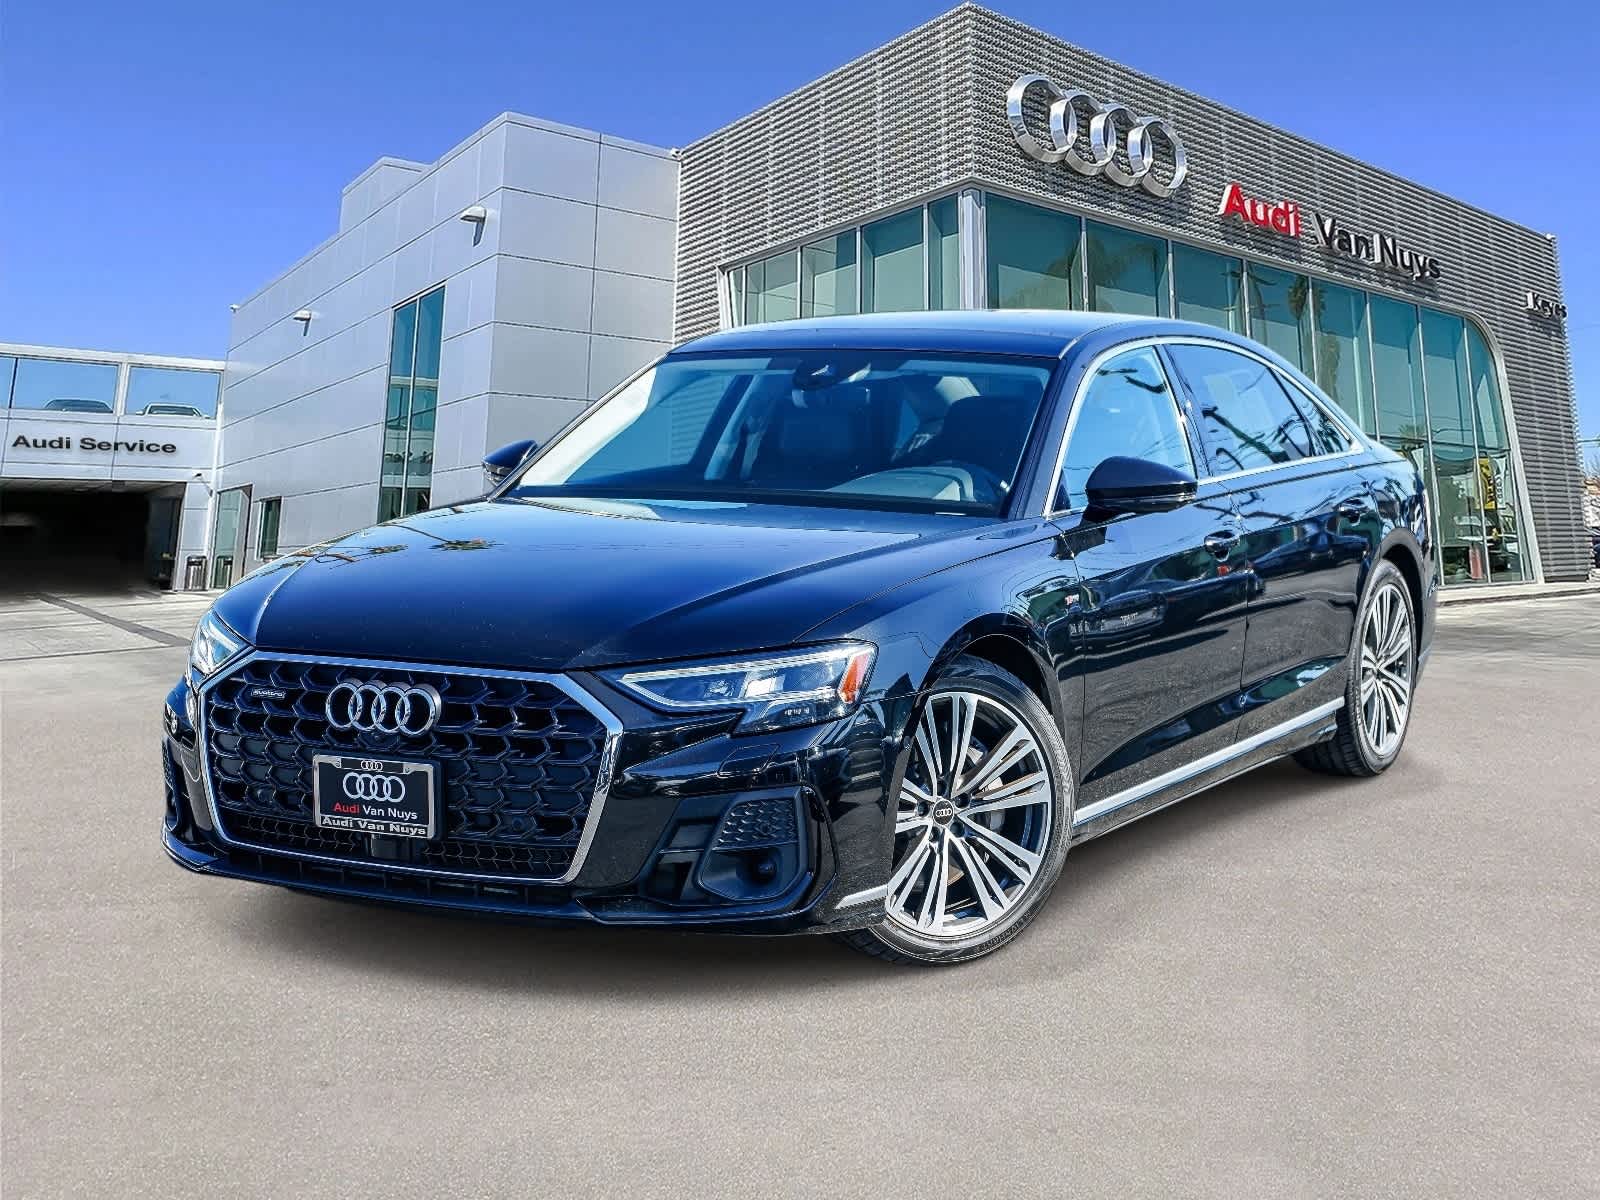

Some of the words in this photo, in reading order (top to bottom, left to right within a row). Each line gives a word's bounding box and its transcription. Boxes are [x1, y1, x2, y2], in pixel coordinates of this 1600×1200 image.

[1219, 182, 1302, 237] Audi
[1311, 212, 1371, 260] Van
[1373, 233, 1441, 280] Nuys
[12, 435, 71, 449] Audi
[79, 437, 177, 454] Service
[333, 802, 360, 814] Audi
[362, 804, 385, 817] Van
[387, 807, 418, 821] Nuys
[322, 817, 353, 828] Audi
[358, 820, 385, 831] Van
[389, 824, 426, 836] Nuys
